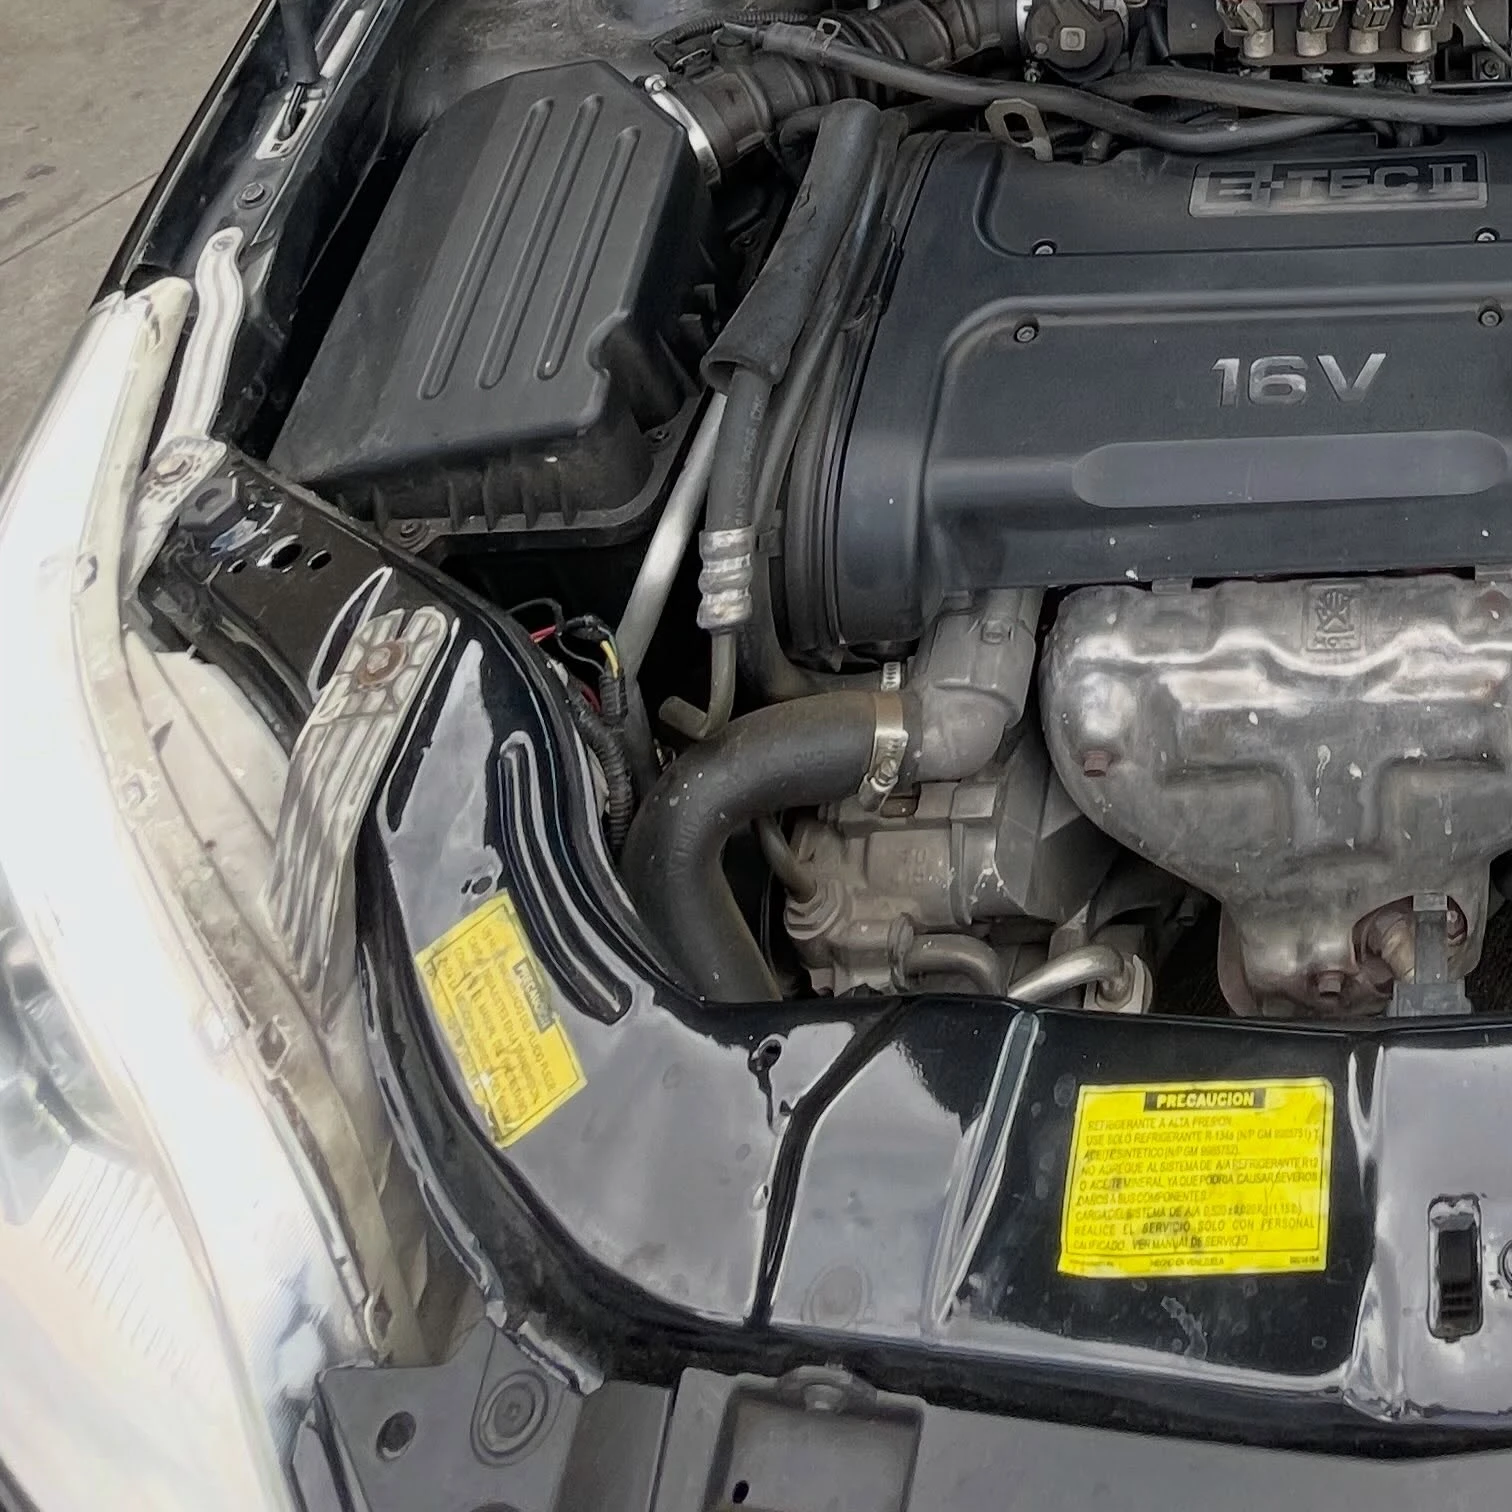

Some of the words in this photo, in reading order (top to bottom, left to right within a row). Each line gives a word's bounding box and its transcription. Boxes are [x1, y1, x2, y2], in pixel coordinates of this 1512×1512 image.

[1211, 351, 1387, 408] 16V
[1156, 1091, 1255, 1108] PRECAUCION
[1123, 1223, 1135, 1235] EL
[1142, 1220, 1191, 1235] SERVICIO
[1197, 1219, 1225, 1233] SOLO
[1232, 1219, 1254, 1231] CON
[1261, 1216, 1315, 1231] PERSONAL
